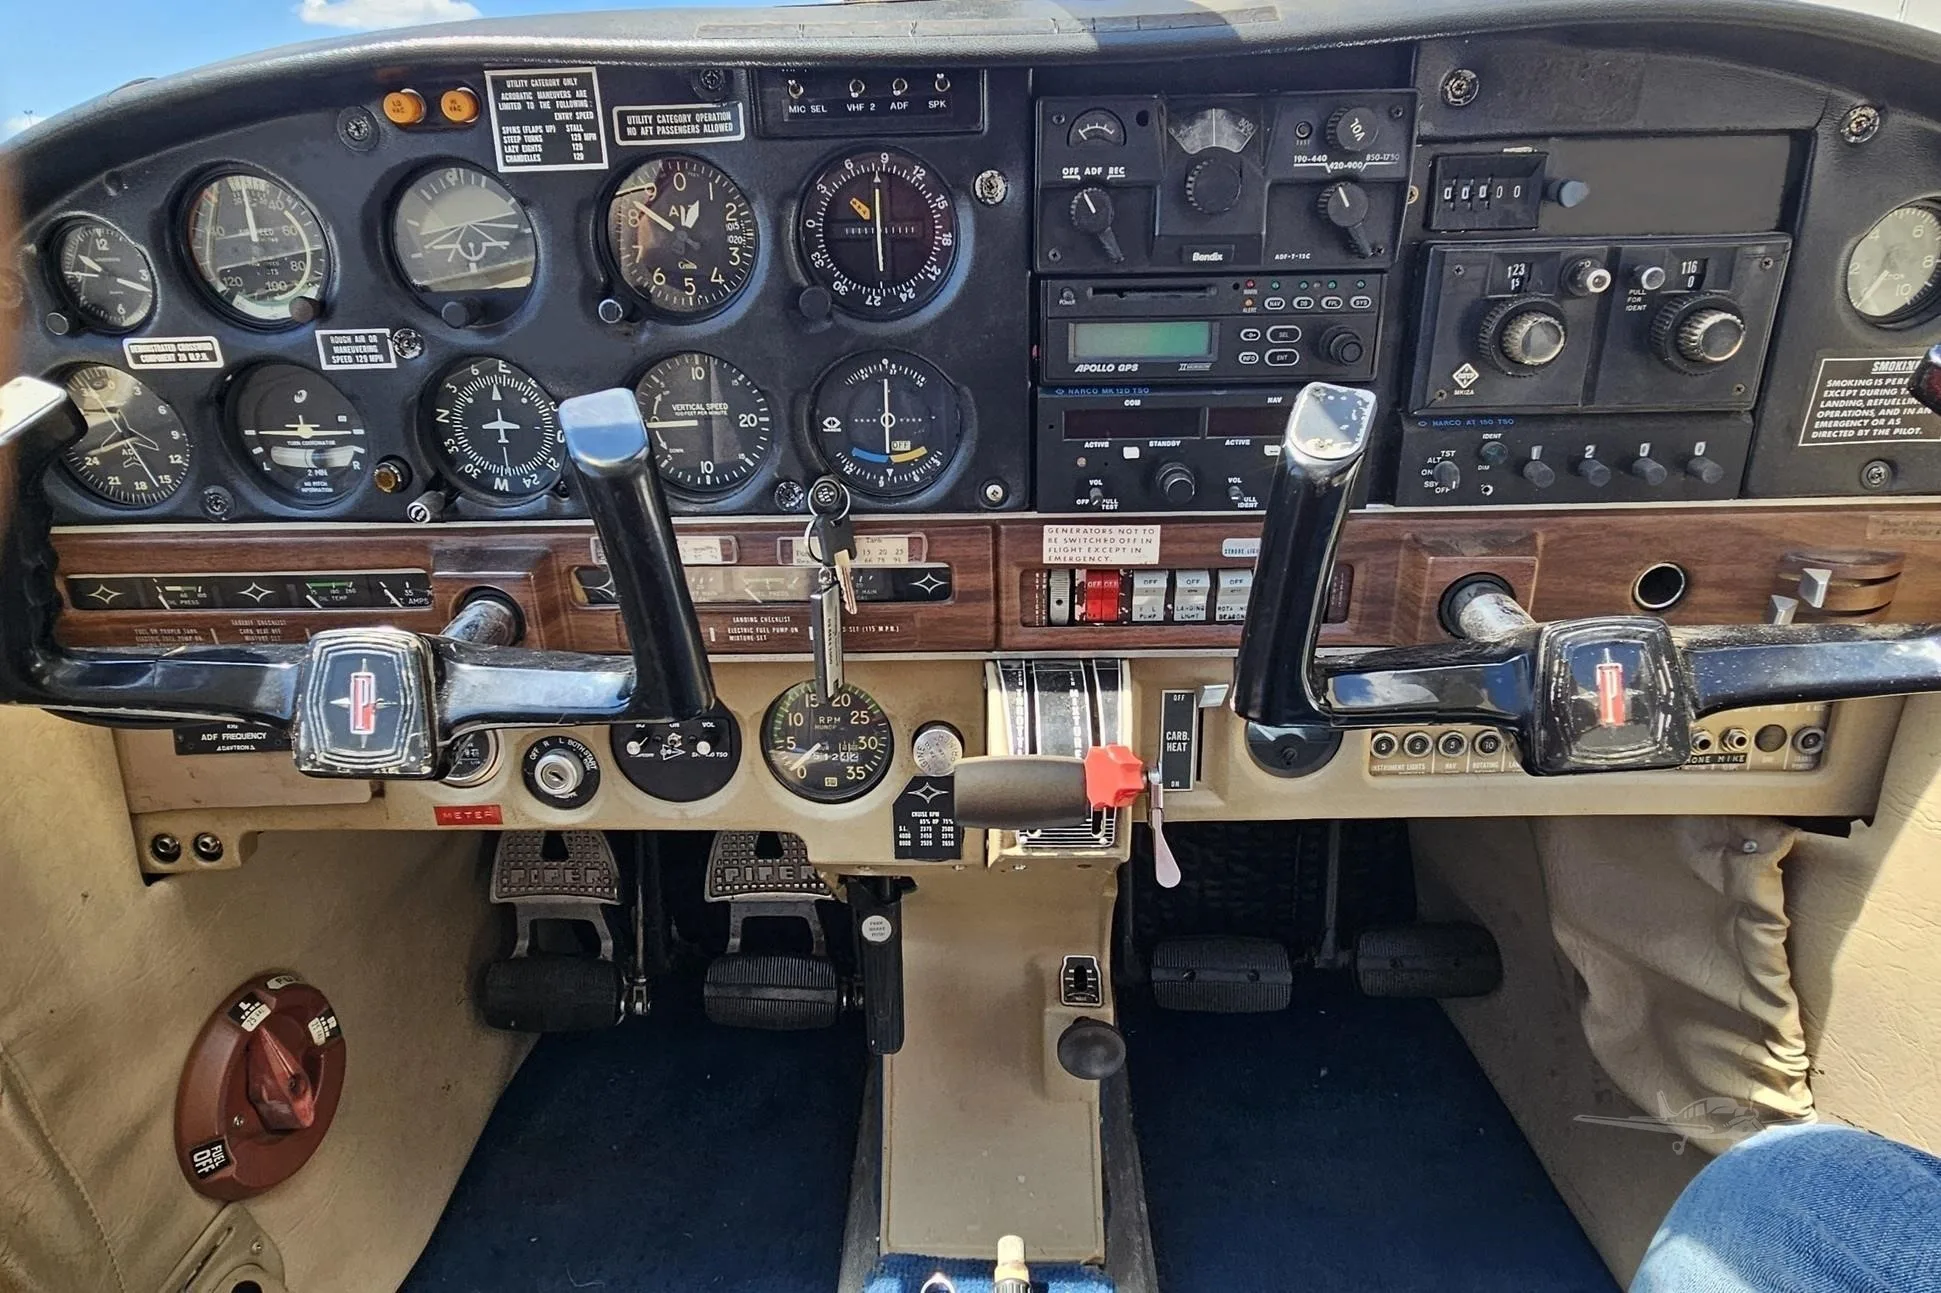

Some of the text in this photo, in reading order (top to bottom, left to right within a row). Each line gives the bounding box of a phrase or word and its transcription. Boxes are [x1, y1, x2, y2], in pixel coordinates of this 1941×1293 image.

[506, 78, 578, 88] UTILITY CATEGORY ONLY
[501, 92, 533, 100] ACROBATIC
[576, 90, 587, 98] ARE
[499, 101, 551, 110] LIMITED TO THE
[789, 105, 827, 114] MIC SEL
[890, 101, 909, 110] ADF
[929, 100, 946, 109] SPK
[554, 111, 594, 120] ENTRY SPEED
[627, 112, 731, 124] UTILITY CATEGORY OPERATION
[502, 124, 584, 134] SPINS STALL
[627, 123, 733, 136] NO AFT PASSENGERS ALLOWED
[1350, 118, 1366, 142] VOL
[503, 135, 522, 144] STEEP
[524, 135, 543, 143] TURNS
[504, 144, 543, 153] LAZY EIGHTS
[506, 154, 541, 163] CHANDELLES
[1062, 167, 1079, 175] OFF
[1084, 167, 1103, 175] ADF
[1109, 167, 1125, 175] REC
[674, 173, 686, 191] 0
[268, 201, 284, 211] 40
[726, 203, 737, 221] 2
[628, 209, 639, 227] 8
[282, 226, 298, 236] 60
[96, 239, 109, 251] 12
[632, 246, 643, 263] 7
[729, 247, 741, 265] 3
[1193, 252, 1223, 261] Bendix
[291, 261, 306, 272] 80
[1507, 263, 1525, 278] 123
[1682, 261, 1698, 275] 116
[653, 268, 666, 285] 6
[711, 267, 725, 284] 4
[222, 277, 243, 287] 120
[685, 278, 696, 295] 5
[1896, 283, 1911, 296] 10
[332, 355, 353, 363] SPEED
[499, 360, 511, 374] E
[1075, 364, 1139, 373] APOLLO GPS
[691, 367, 705, 380] 10
[1827, 379, 1873, 387] SMOKING
[134, 387, 142, 395] 3
[1824, 388, 1897, 398] EXCEPT DURING
[1821, 398, 1921, 408] LANDING, REFUELLIN
[158, 405, 167, 415] 6
[1817, 409, 1876, 418] OPERATIONS,
[739, 414, 757, 427] 20
[1815, 420, 1870, 429] EMERGENCY
[171, 431, 180, 439] 9
[1812, 430, 1855, 438] DIRECTED
[1893, 427, 1922, 435] PILOT.
[85, 457, 100, 466] 24
[169, 455, 183, 464] 12
[701, 461, 714, 473] 10
[108, 476, 121, 485] 21
[159, 475, 172, 484] 15
[134, 482, 148, 490] 18
[805, 694, 819, 708] 15
[789, 712, 804, 726] 10
[851, 711, 870, 725] 25
[222, 732, 267, 740] FREQUENCY
[1166, 732, 1190, 741] CARB.
[568, 739, 586, 752] BOTH
[787, 736, 796, 750] 5
[858, 736, 878, 750] 30
[1167, 742, 1187, 752] HEAT
[530, 747, 540, 760] OFF
[584, 750, 598, 769] START
[797, 766, 807, 779] 0
[846, 766, 866, 780] 35
[443, 811, 494, 819] METER
[511, 869, 602, 884] PIPER
[725, 866, 816, 881] PIPER
[211, 1144, 227, 1166] FUEL
[193, 1149, 215, 1174] OFF
